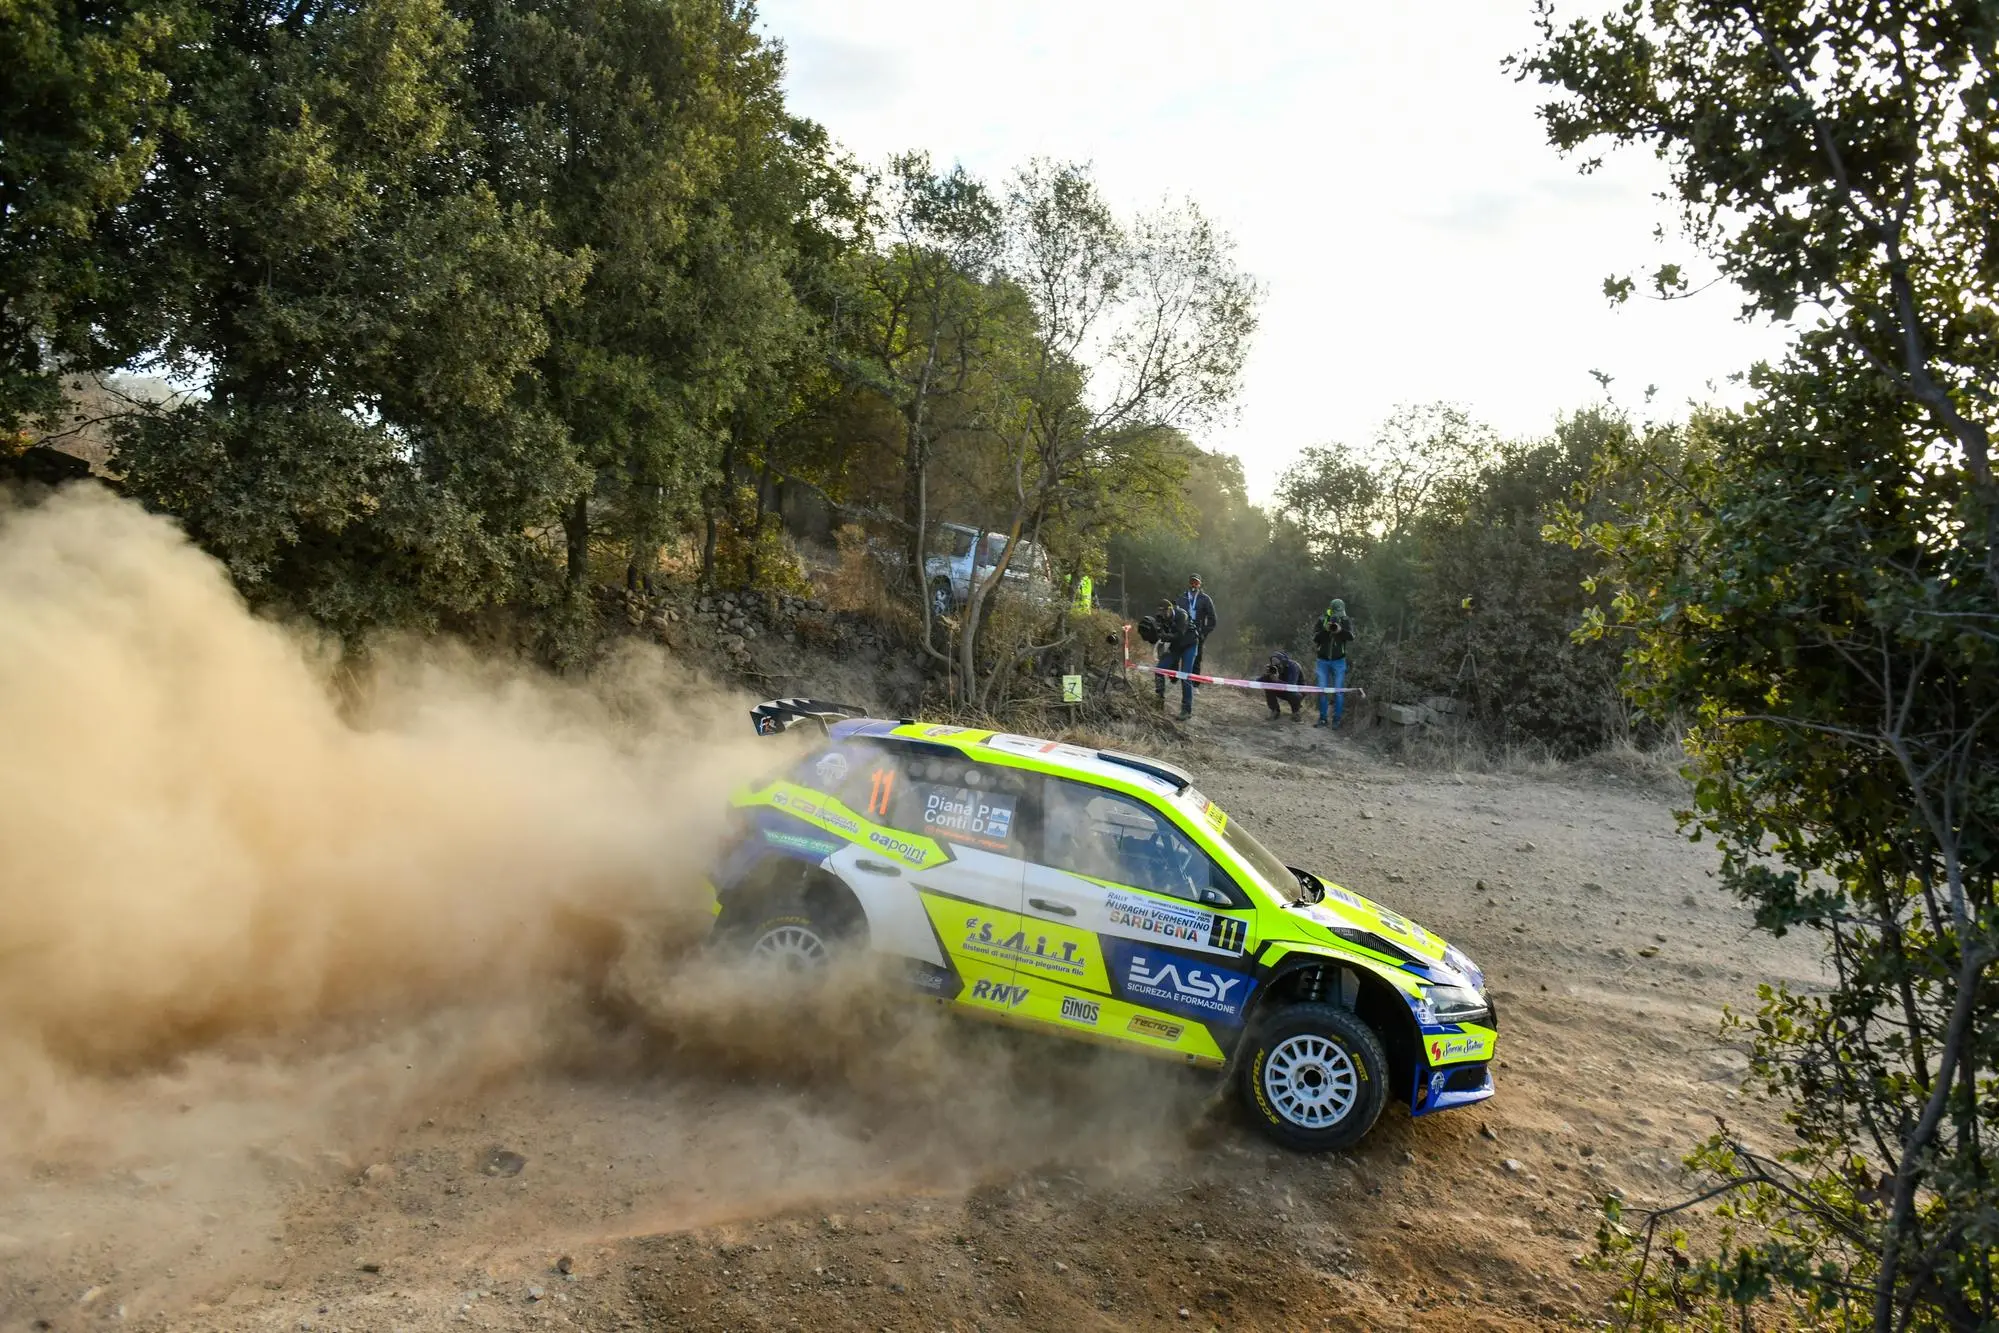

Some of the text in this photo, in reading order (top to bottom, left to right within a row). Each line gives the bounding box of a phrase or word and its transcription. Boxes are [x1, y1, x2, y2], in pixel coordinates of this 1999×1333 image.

[868, 768, 896, 816] 11
[927, 795, 973, 816] Diana
[924, 809, 967, 829] Conti
[1107, 891, 1128, 902] RALLY
[1105, 900, 1148, 916] NURAGHI
[1151, 910, 1210, 932] VERMENTINO
[1109, 910, 1198, 943] SARDEGNA
[1218, 919, 1239, 950] 11
[1071, 967, 1084, 976] filo
[1128, 956, 1241, 1002] EASY
[972, 979, 1031, 1006] RNV
[1127, 982, 1236, 1014] SICUREZZA E FORMAZIONE
[1061, 999, 1100, 1022] GINOS
[1252, 1048, 1279, 1125] SCORPION
